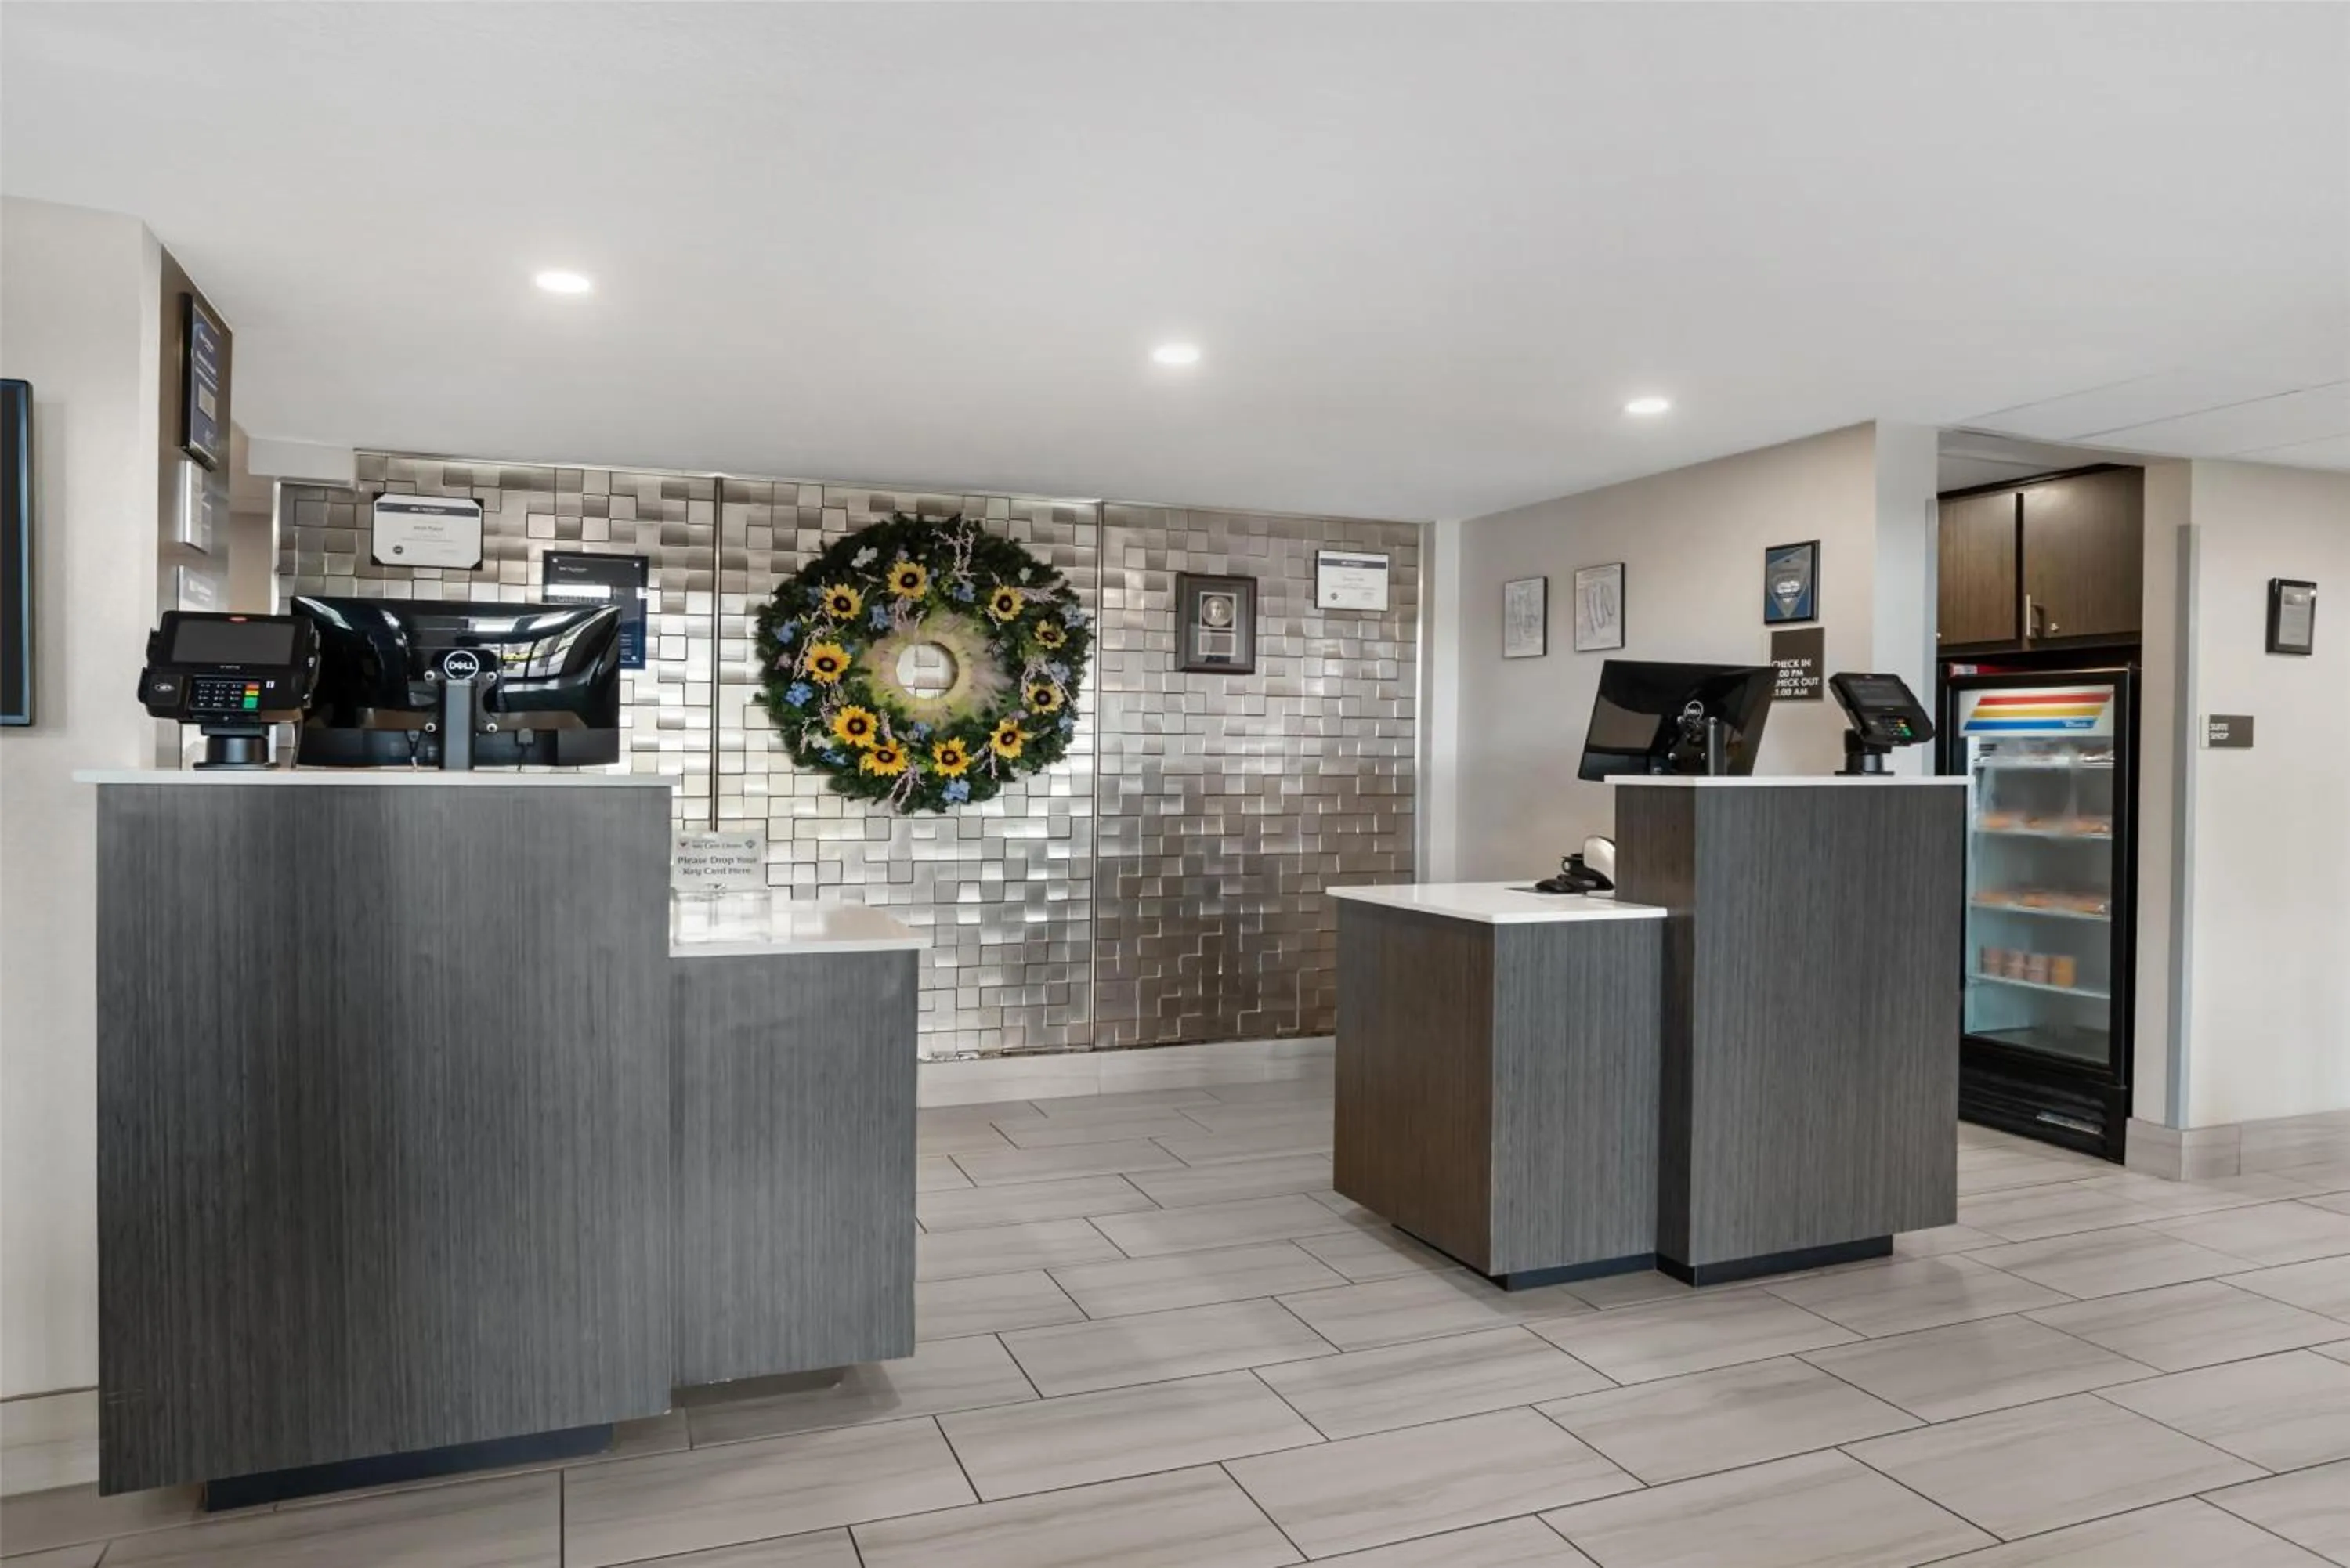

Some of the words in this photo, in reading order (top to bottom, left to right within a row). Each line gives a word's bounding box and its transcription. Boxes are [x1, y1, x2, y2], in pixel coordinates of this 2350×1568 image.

[449, 660, 475, 670] DELL
[1776, 678, 1799, 687] HECK
[1801, 677, 1820, 686] OUT
[710, 856, 734, 865] Drop
[682, 868, 702, 876] Key
